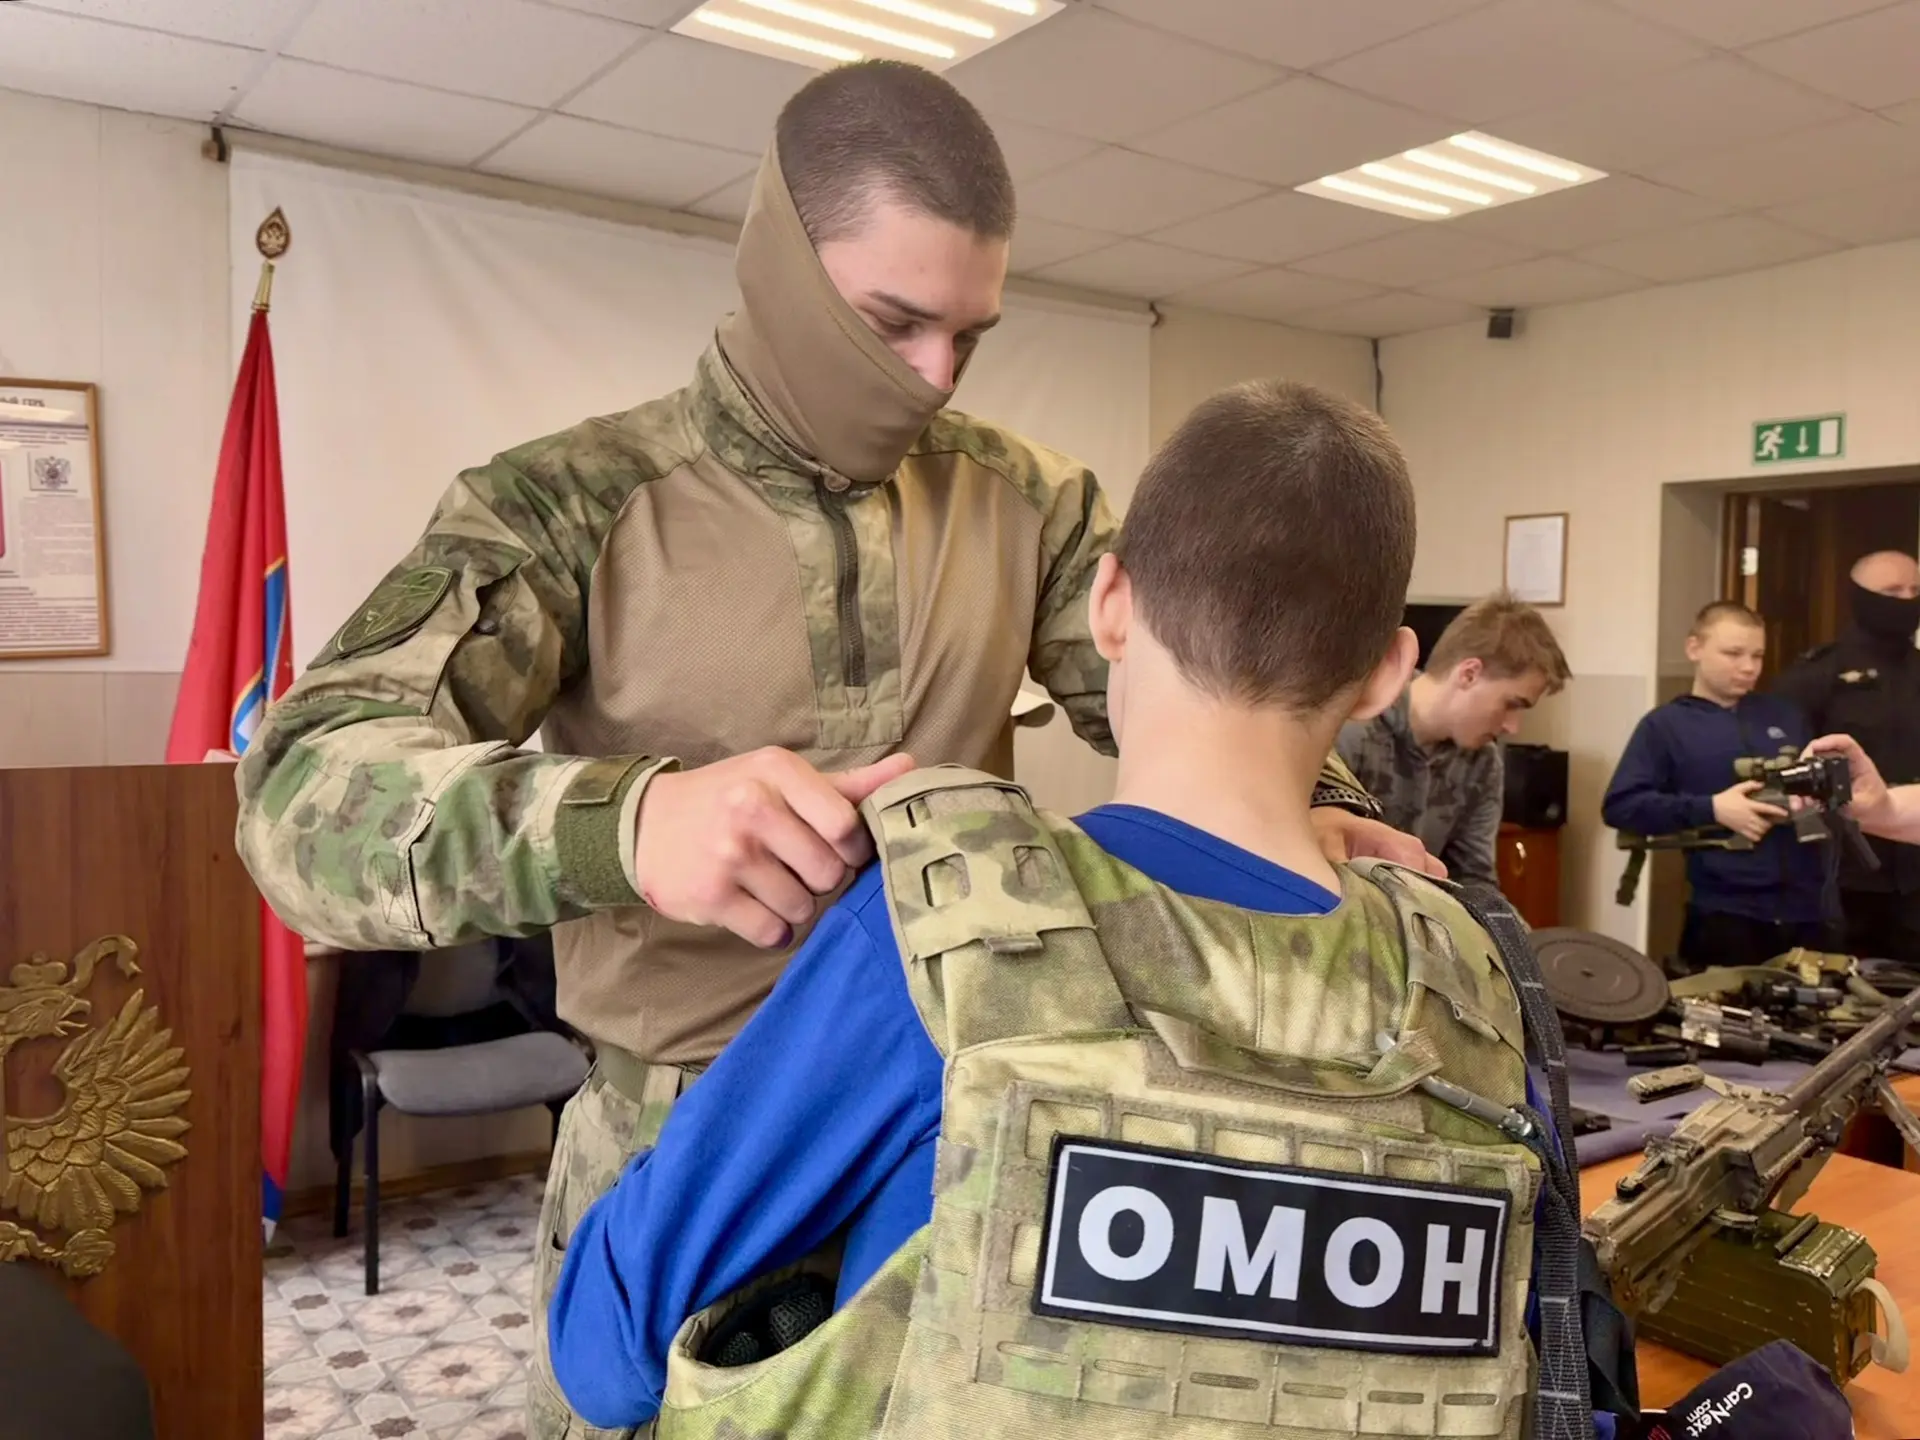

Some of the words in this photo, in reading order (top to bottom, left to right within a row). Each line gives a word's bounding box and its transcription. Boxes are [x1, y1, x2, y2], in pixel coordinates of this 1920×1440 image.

[1077, 1185, 1486, 1316] ОМОН
[1685, 1382, 1754, 1438] CarNext
[1685, 1398, 1712, 1423] .com
